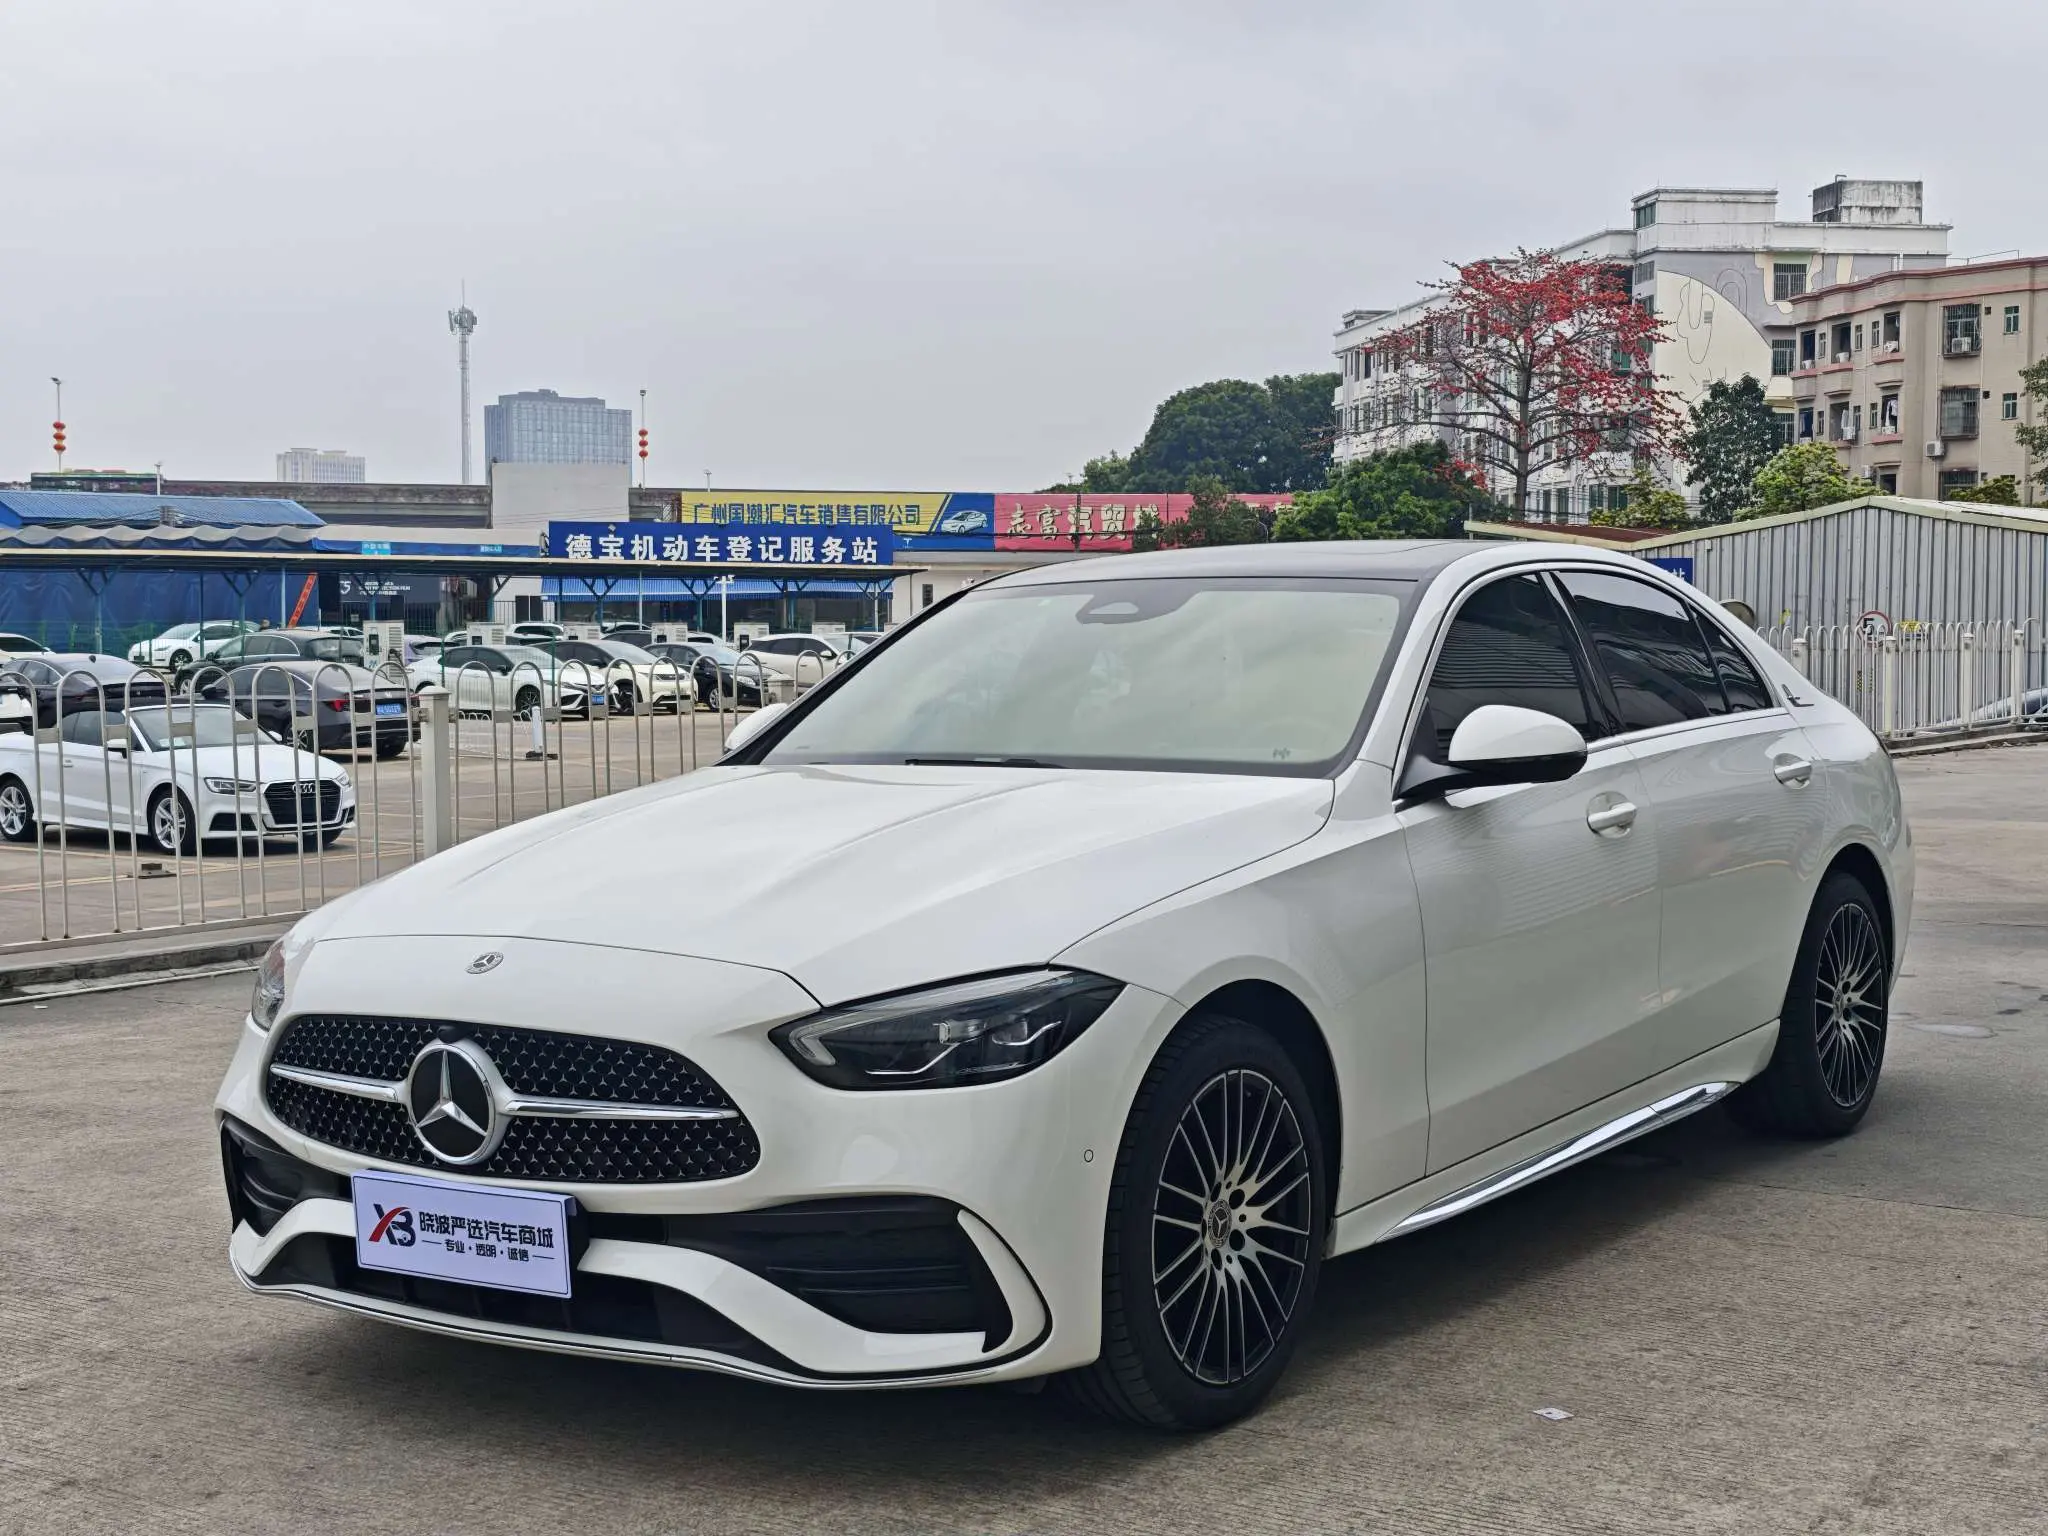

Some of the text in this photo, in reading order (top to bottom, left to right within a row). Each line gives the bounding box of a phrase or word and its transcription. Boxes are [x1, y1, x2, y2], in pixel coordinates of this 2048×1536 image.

[694, 503, 921, 526] 广州国潮汇汽车销售有限公司
[565, 533, 878, 563] 德宝机动车登记服务站
[419, 1211, 555, 1249] 晓波严选汽车商城
